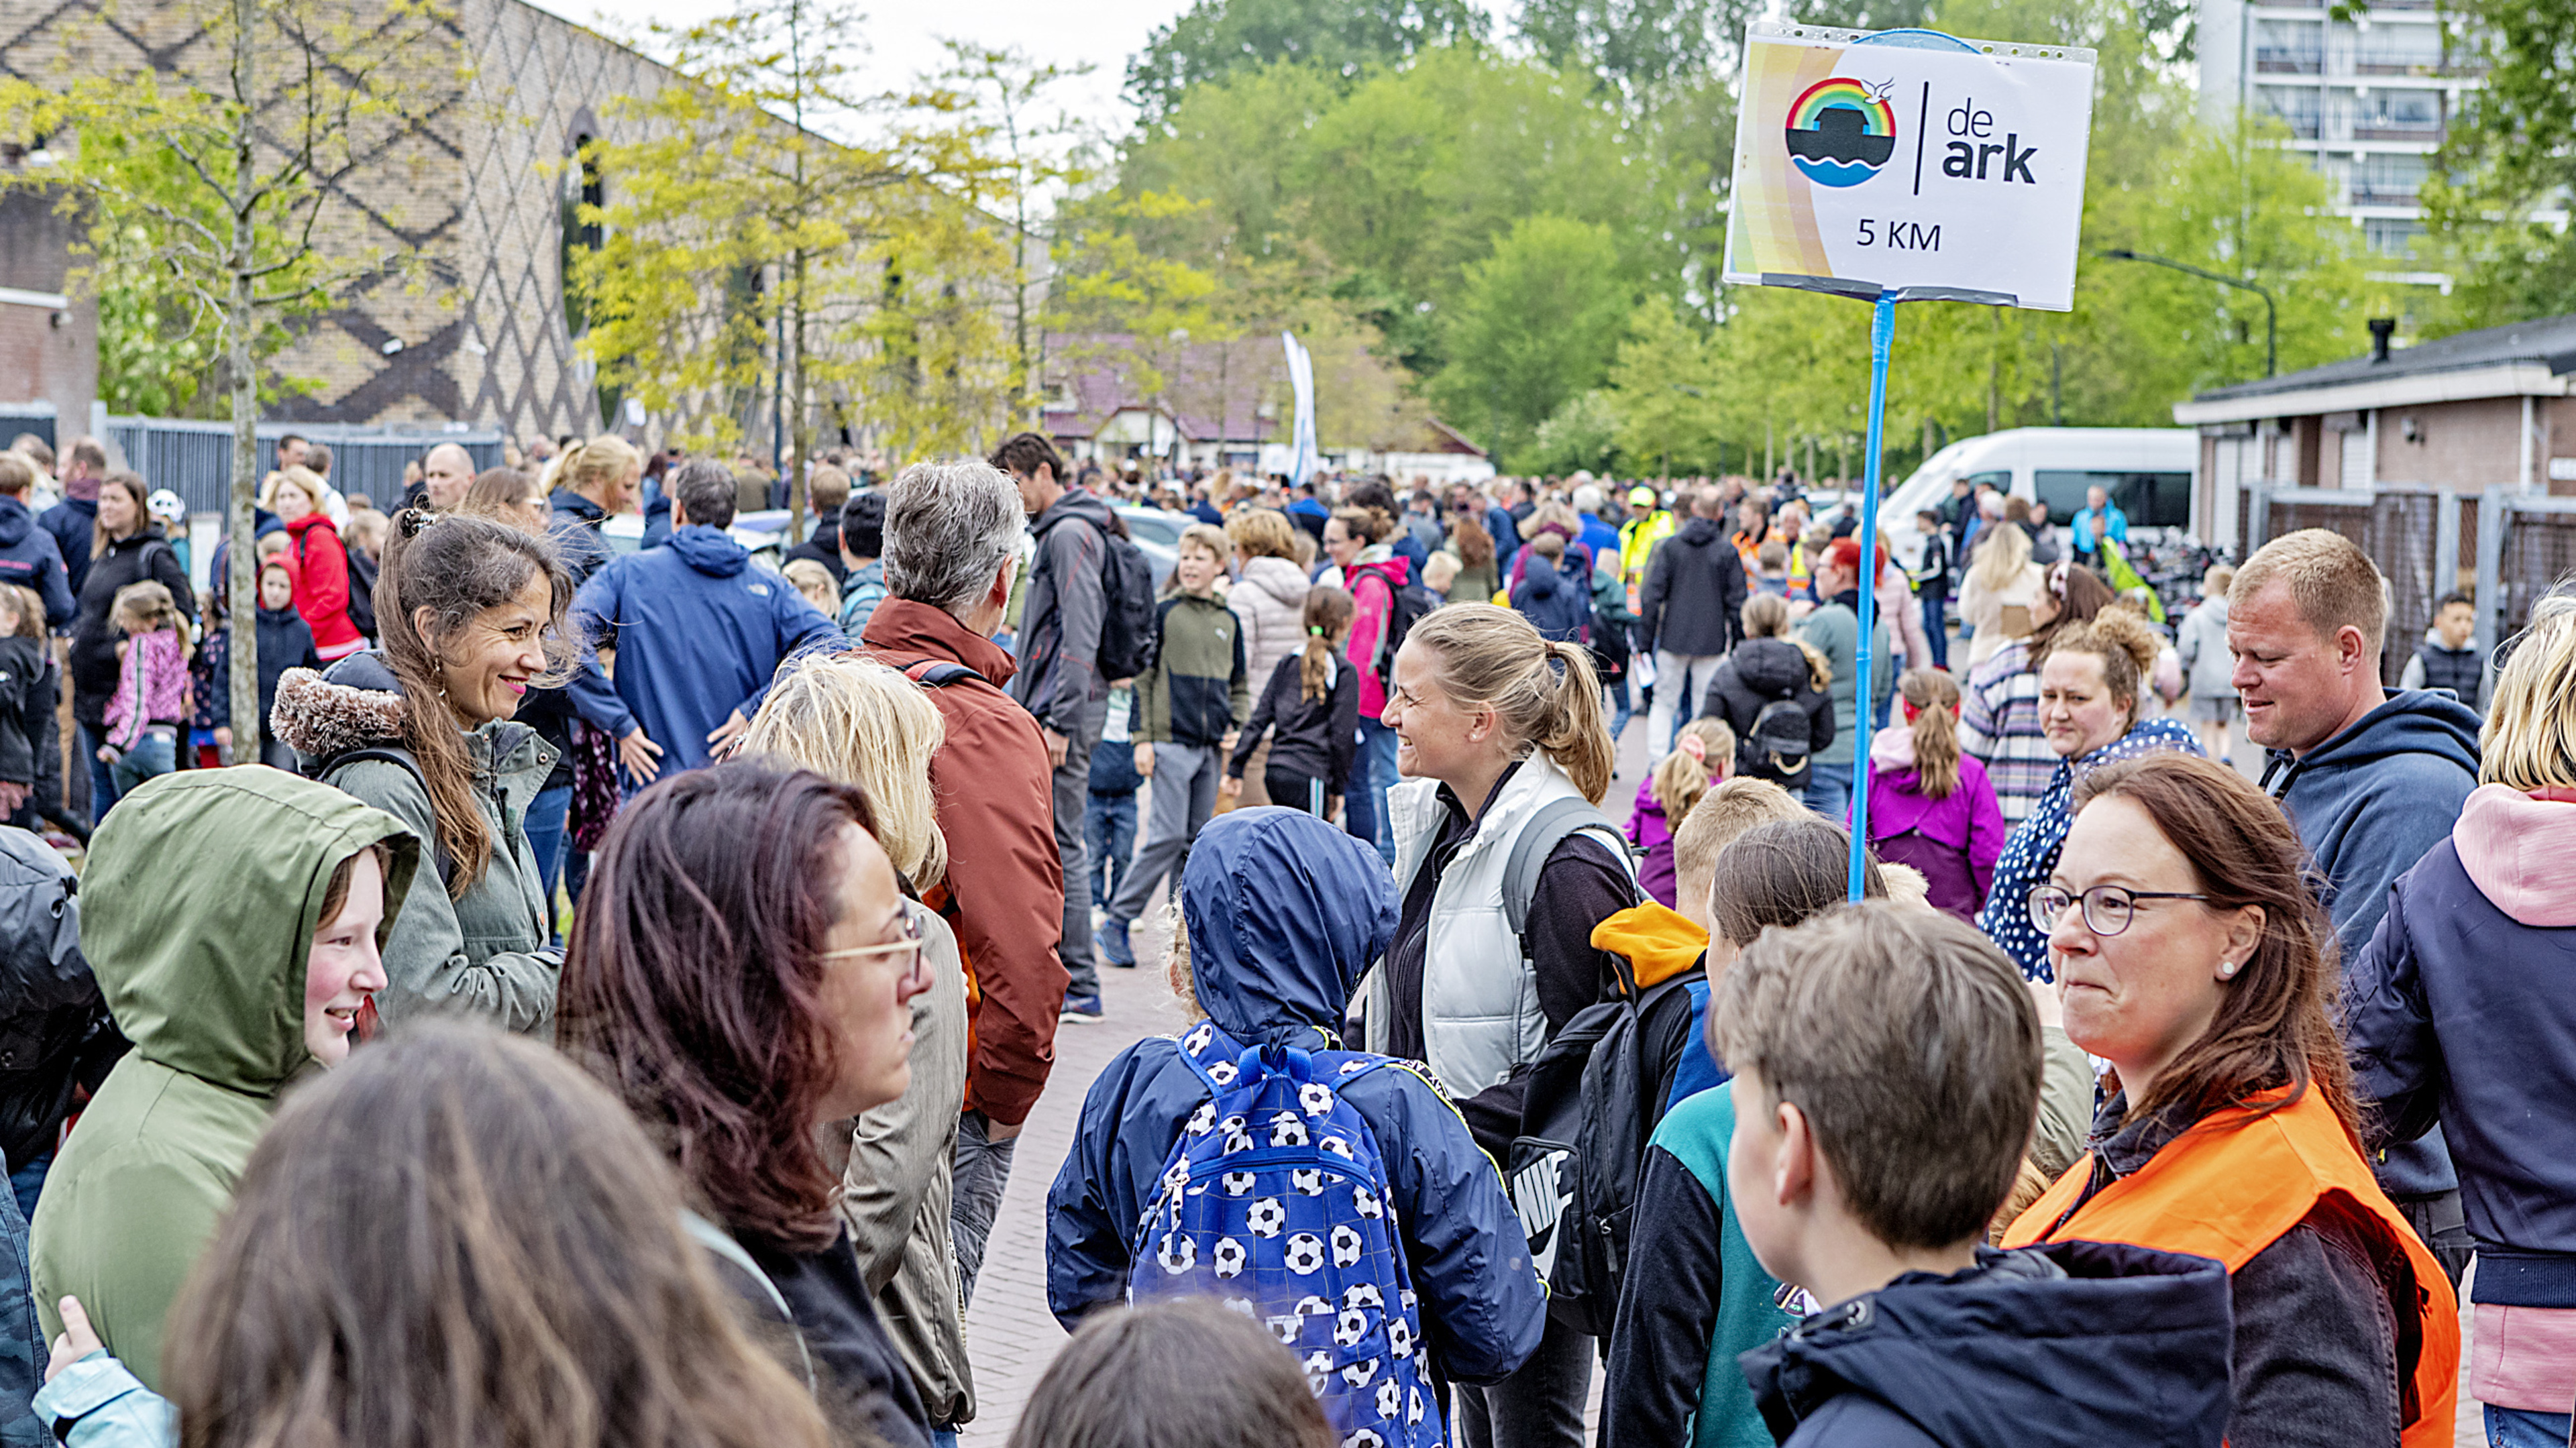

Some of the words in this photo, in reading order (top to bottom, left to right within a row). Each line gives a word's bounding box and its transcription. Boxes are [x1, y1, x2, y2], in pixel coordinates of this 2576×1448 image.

[1947, 97, 1992, 137] de
[1943, 133, 2038, 184] ark
[1857, 219, 1874, 246] 5
[1888, 221, 1940, 252] KM
[1513, 1150, 1571, 1240] NIKE
